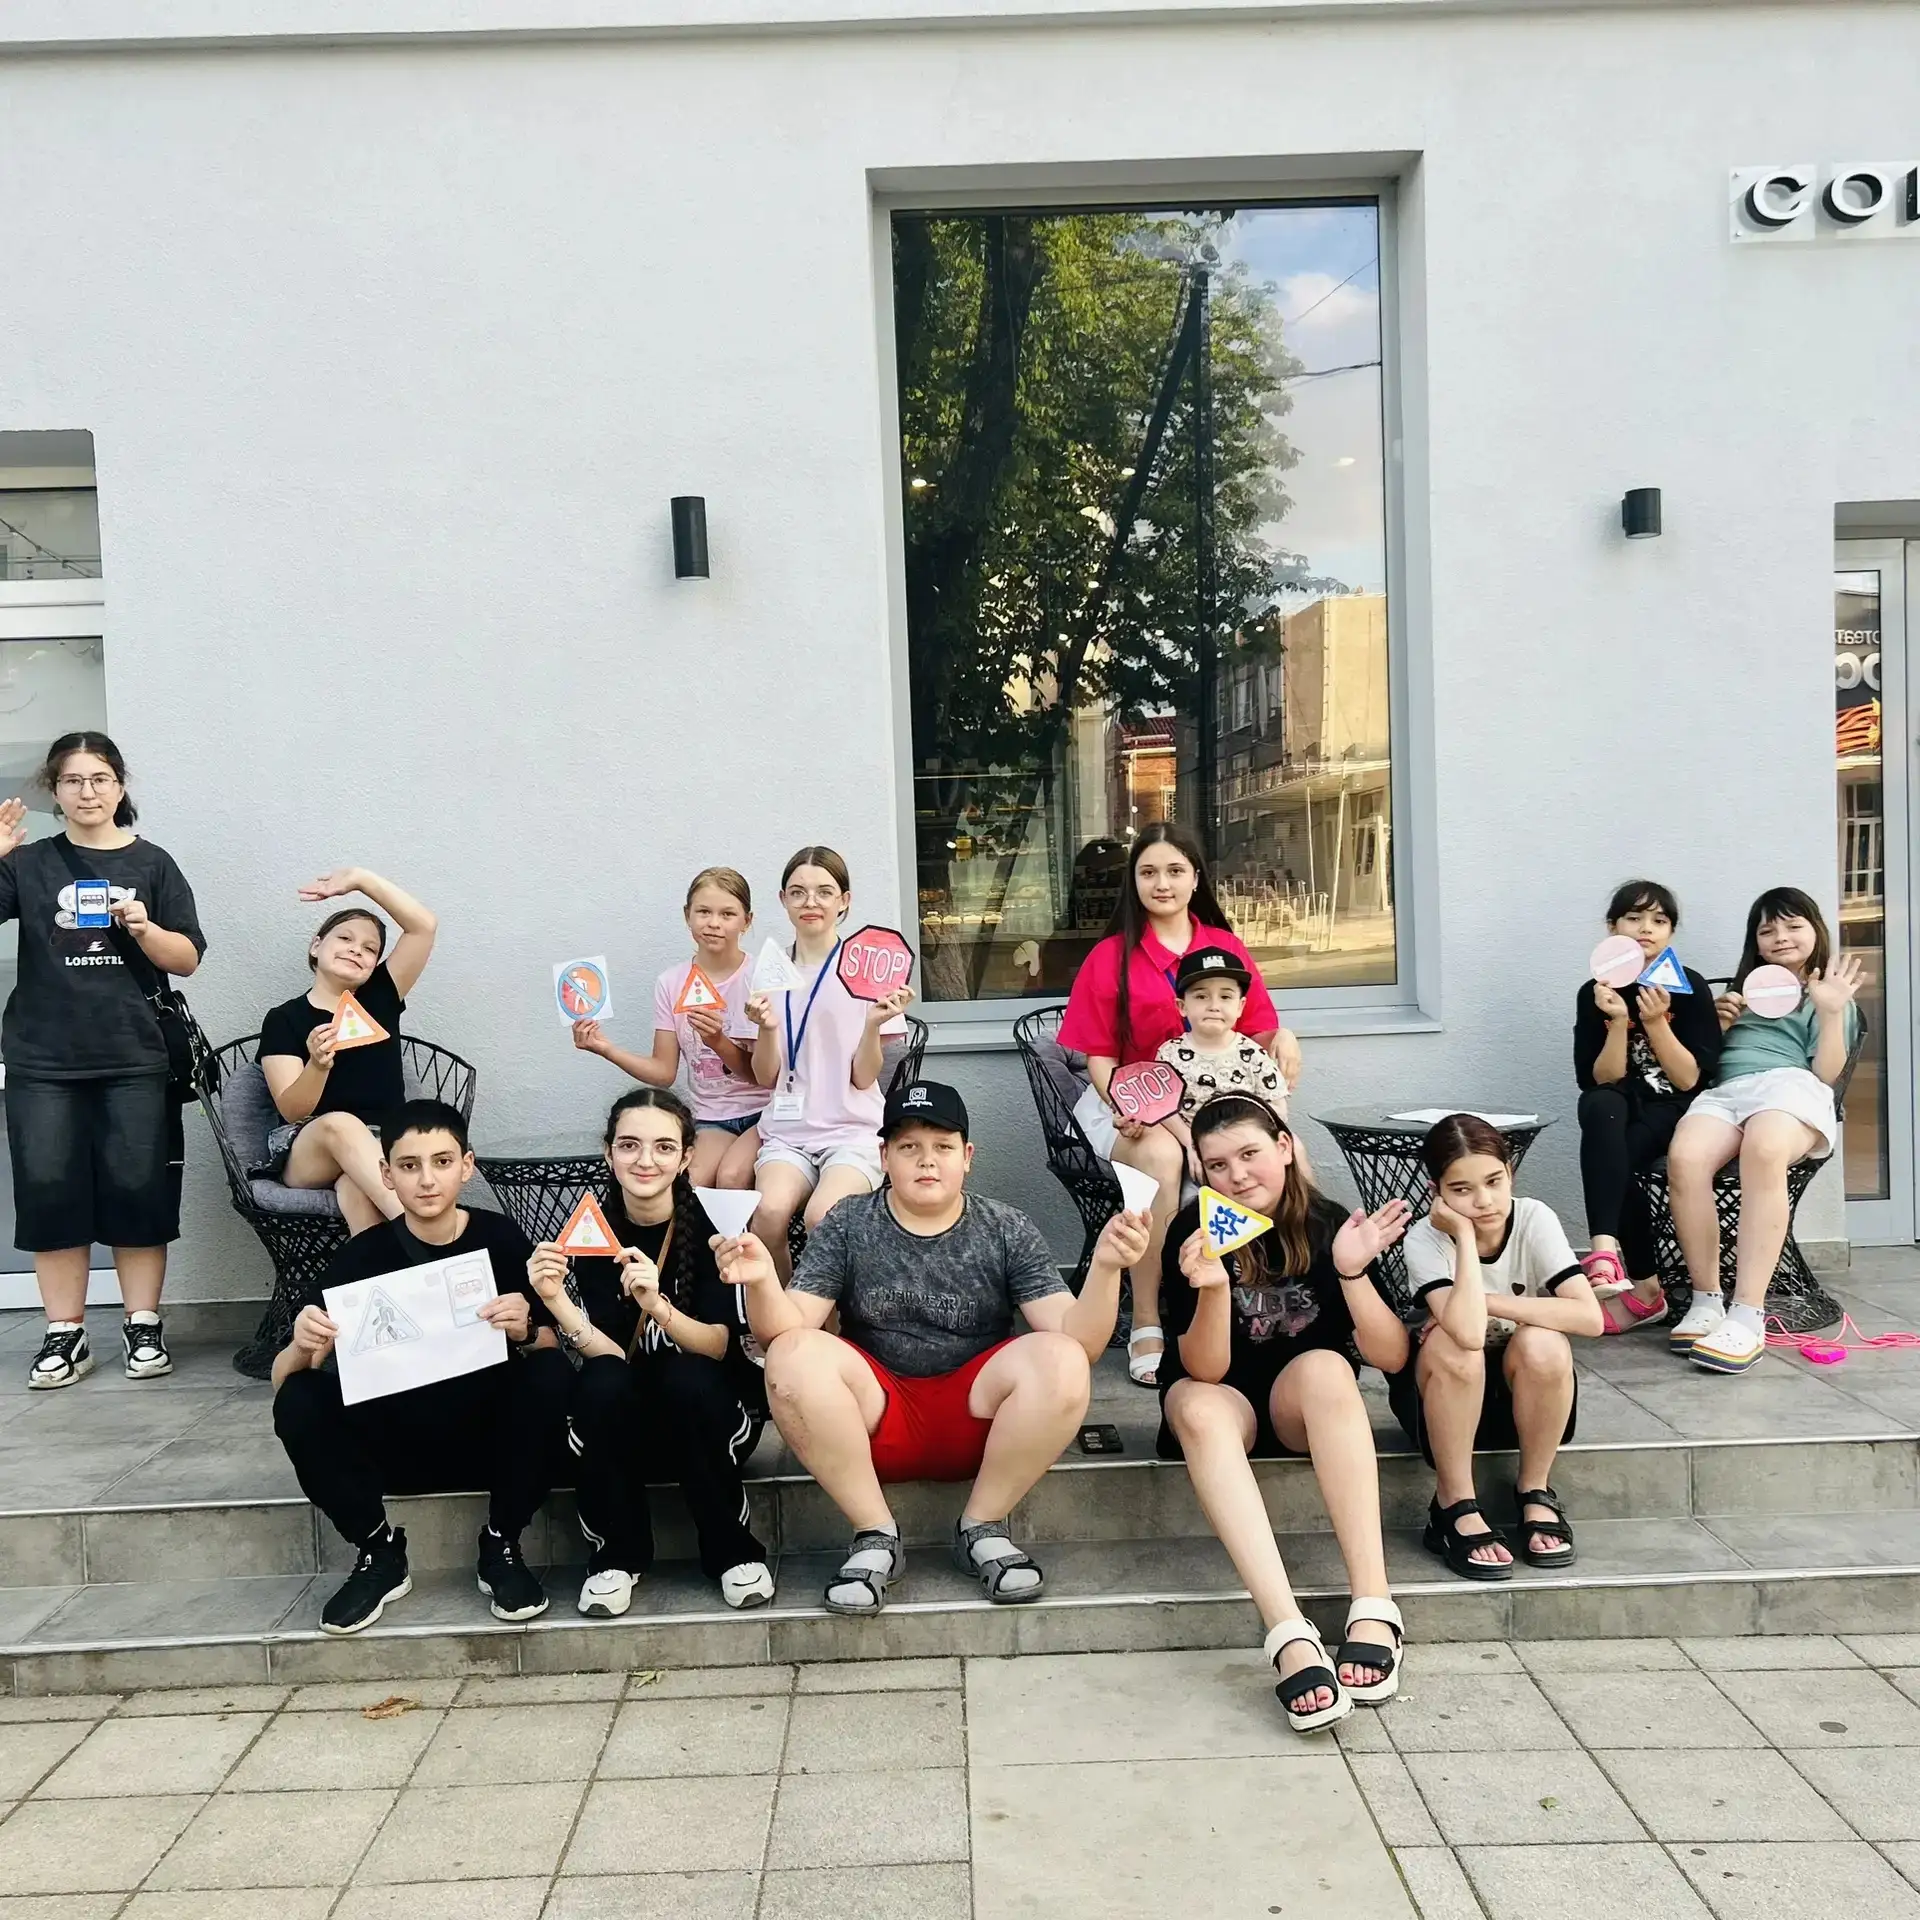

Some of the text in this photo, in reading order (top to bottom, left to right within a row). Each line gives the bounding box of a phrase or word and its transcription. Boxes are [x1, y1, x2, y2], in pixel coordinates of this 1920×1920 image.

[1745, 166, 1920, 227] CO
[65, 956, 124, 966] LOSTCTRL
[845, 943, 906, 984] STOP
[1116, 1066, 1172, 1114] STOP
[1238, 1288, 1313, 1314] VIBES
